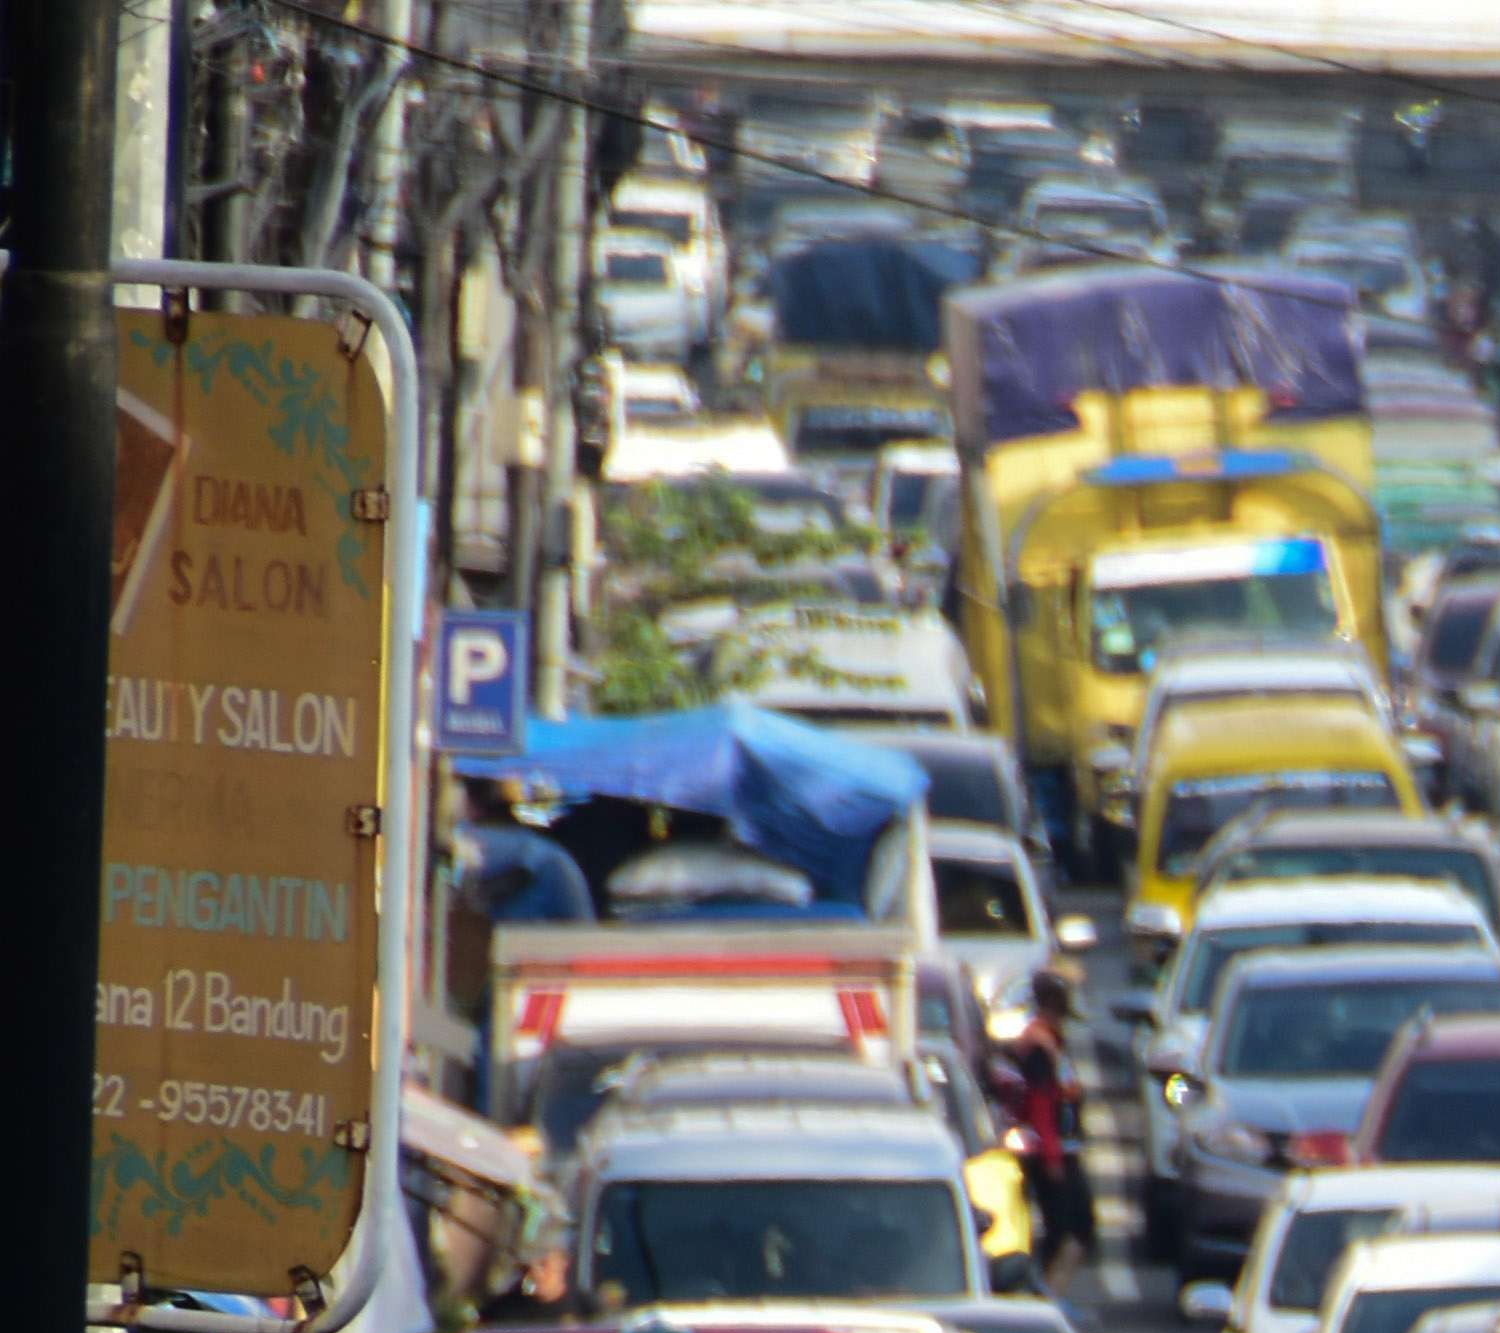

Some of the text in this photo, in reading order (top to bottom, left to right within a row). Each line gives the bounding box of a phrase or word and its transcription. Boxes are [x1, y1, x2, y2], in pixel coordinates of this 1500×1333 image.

[194, 475, 307, 536] DIANA
[169, 550, 329, 617] SALON
[450, 630, 506, 705] P
[217, 686, 356, 758] SALON
[105, 862, 349, 943] PENGANTIN
[165, 968, 195, 1031] 12
[205, 970, 348, 1064] Bandung
